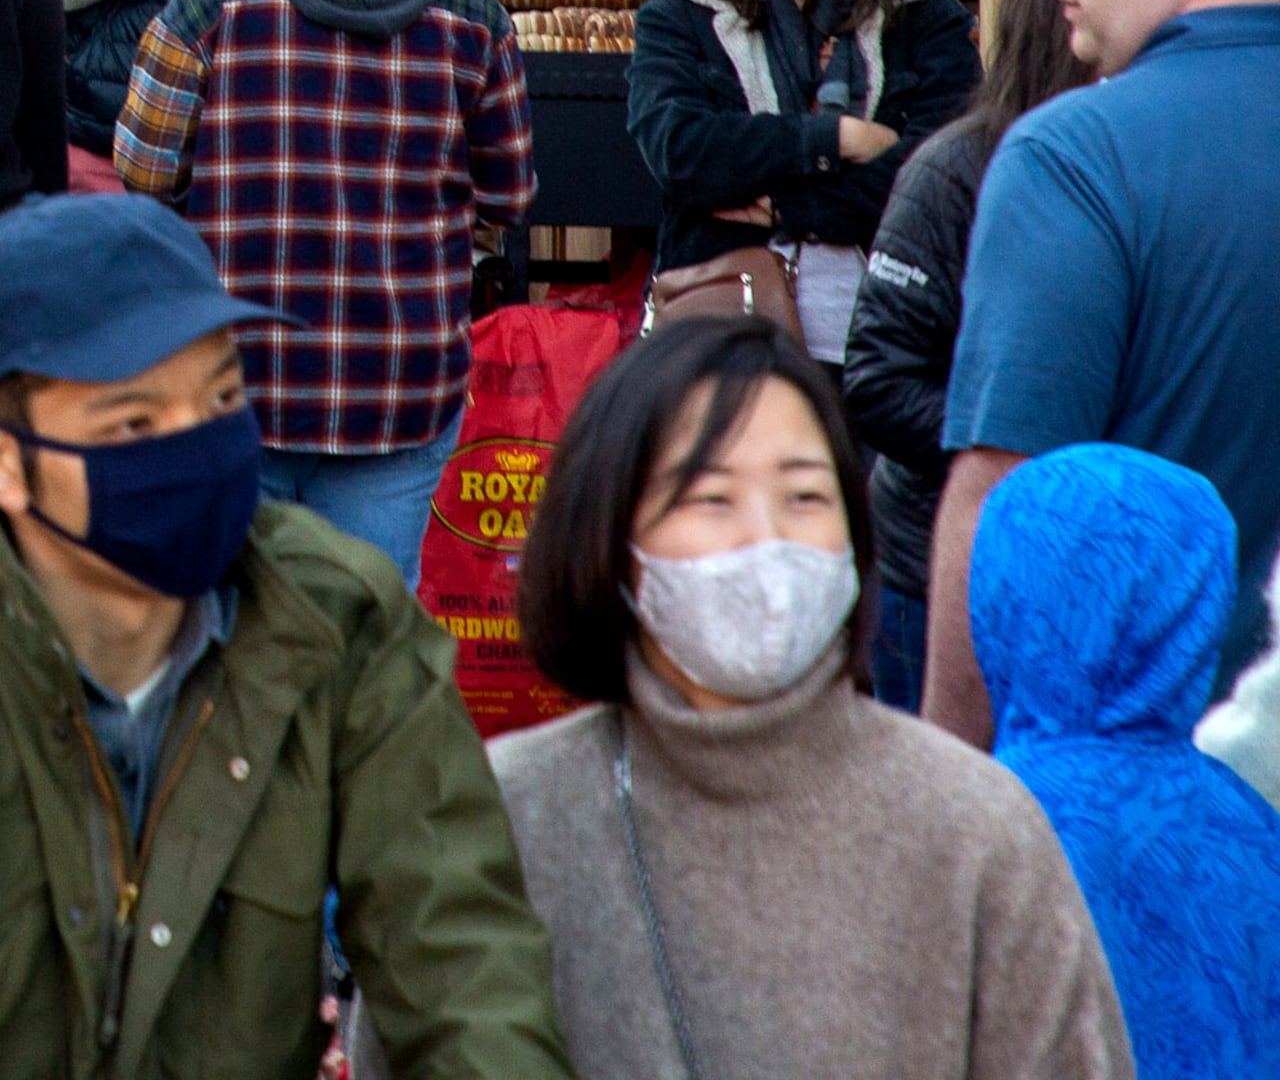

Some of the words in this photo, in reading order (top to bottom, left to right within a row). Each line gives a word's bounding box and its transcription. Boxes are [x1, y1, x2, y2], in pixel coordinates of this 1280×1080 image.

[460, 471, 547, 503] ROYA
[479, 508, 534, 538] OA
[439, 594, 482, 612] 100%
